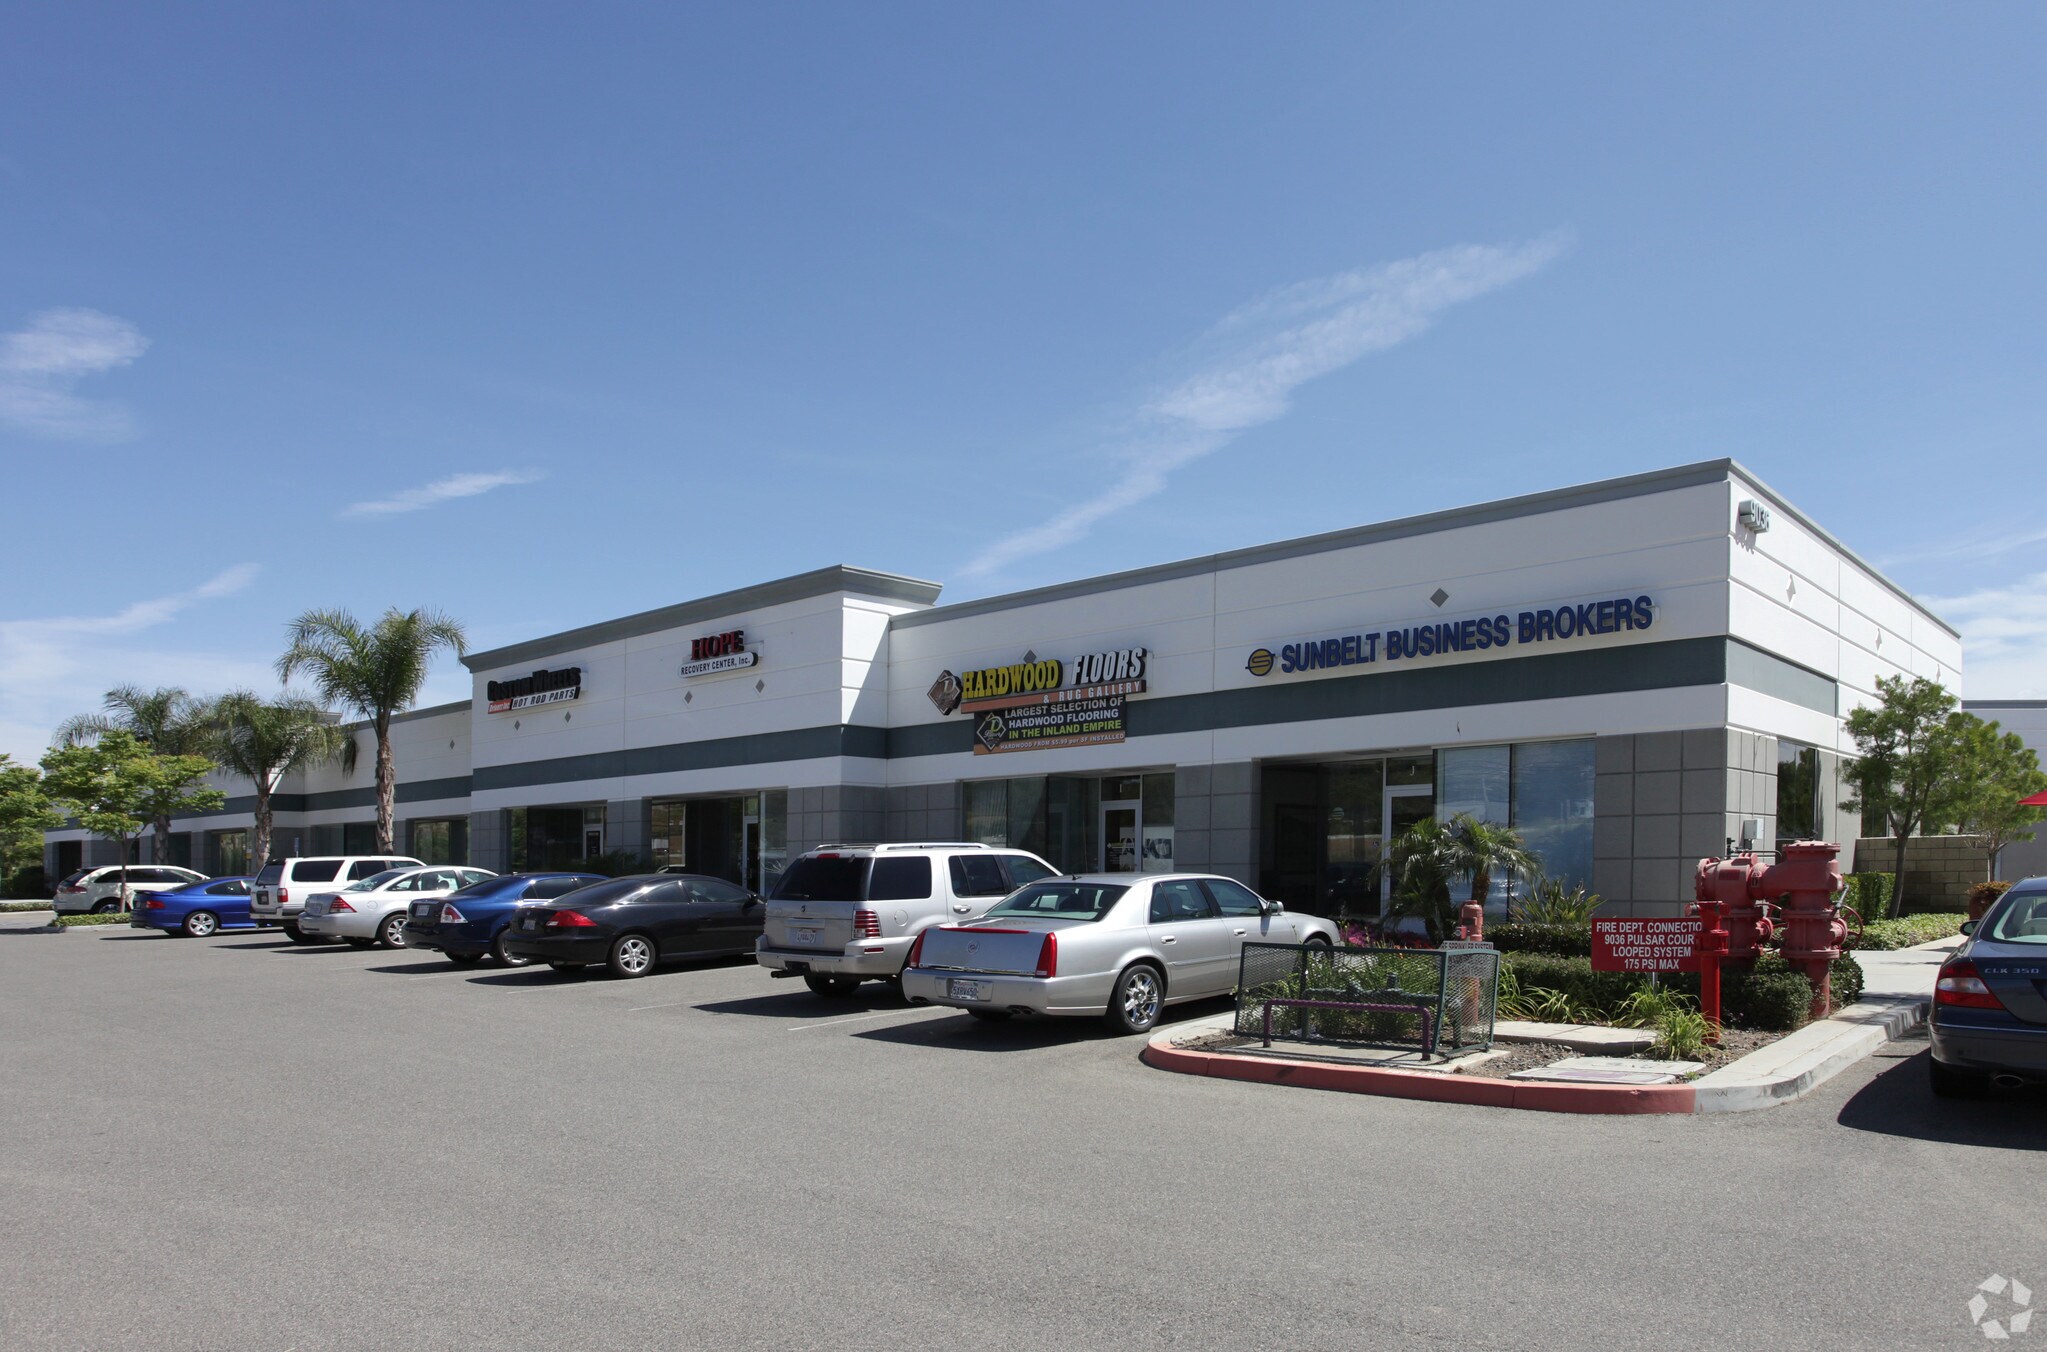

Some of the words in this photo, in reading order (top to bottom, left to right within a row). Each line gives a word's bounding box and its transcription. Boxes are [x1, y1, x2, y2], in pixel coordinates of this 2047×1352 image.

[1751, 500, 1769, 532] 9036
[1281, 633, 1380, 673] SUNBELT
[1387, 615, 1511, 660] BUSINESS
[1518, 596, 1653, 644] BROKERS
[691, 630, 744, 661] HOPE
[681, 663, 711, 675] RECOVERY
[711, 657, 737, 670] CENTER,
[738, 657, 751, 666] Inc.
[962, 659, 1061, 699] HARDWOOD
[1071, 647, 1145, 685] FLOORS
[513, 697, 529, 708] HOT
[530, 694, 547, 704] ROD
[549, 689, 575, 702] PARTS
[1043, 694, 1050, 704] &
[1059, 689, 1082, 702] RUG
[1088, 681, 1140, 698] GALLERY
[1005, 706, 1048, 719] LARGEST
[1051, 699, 1107, 714] SELECTION
[1110, 697, 1123, 707] OF
[1009, 716, 1064, 729] HARDWOOD
[1067, 709, 1119, 723] FLOORING
[1009, 730, 1019, 739] IN
[1022, 727, 1041, 738] THE
[1043, 724, 1080, 737] INLAND
[1083, 720, 1122, 732] EMPIRE
[1000, 742, 1033, 750] HARDWOOD
[1090, 733, 1124, 742] INSTALLED
[1596, 922, 1617, 933] FIRE
[1619, 922, 1645, 933] DEPT.
[1647, 922, 1703, 933] CONNECTIO
[1604, 934, 1625, 945] 9036
[1627, 934, 1665, 945] PULSAR
[1667, 934, 1695, 945] COUR
[1612, 946, 1651, 957] LOOPED
[1653, 946, 1692, 957] SYSTEM
[1624, 959, 1640, 969] 175
[1641, 959, 1657, 970] PSI
[1659, 959, 1680, 970] MAX
